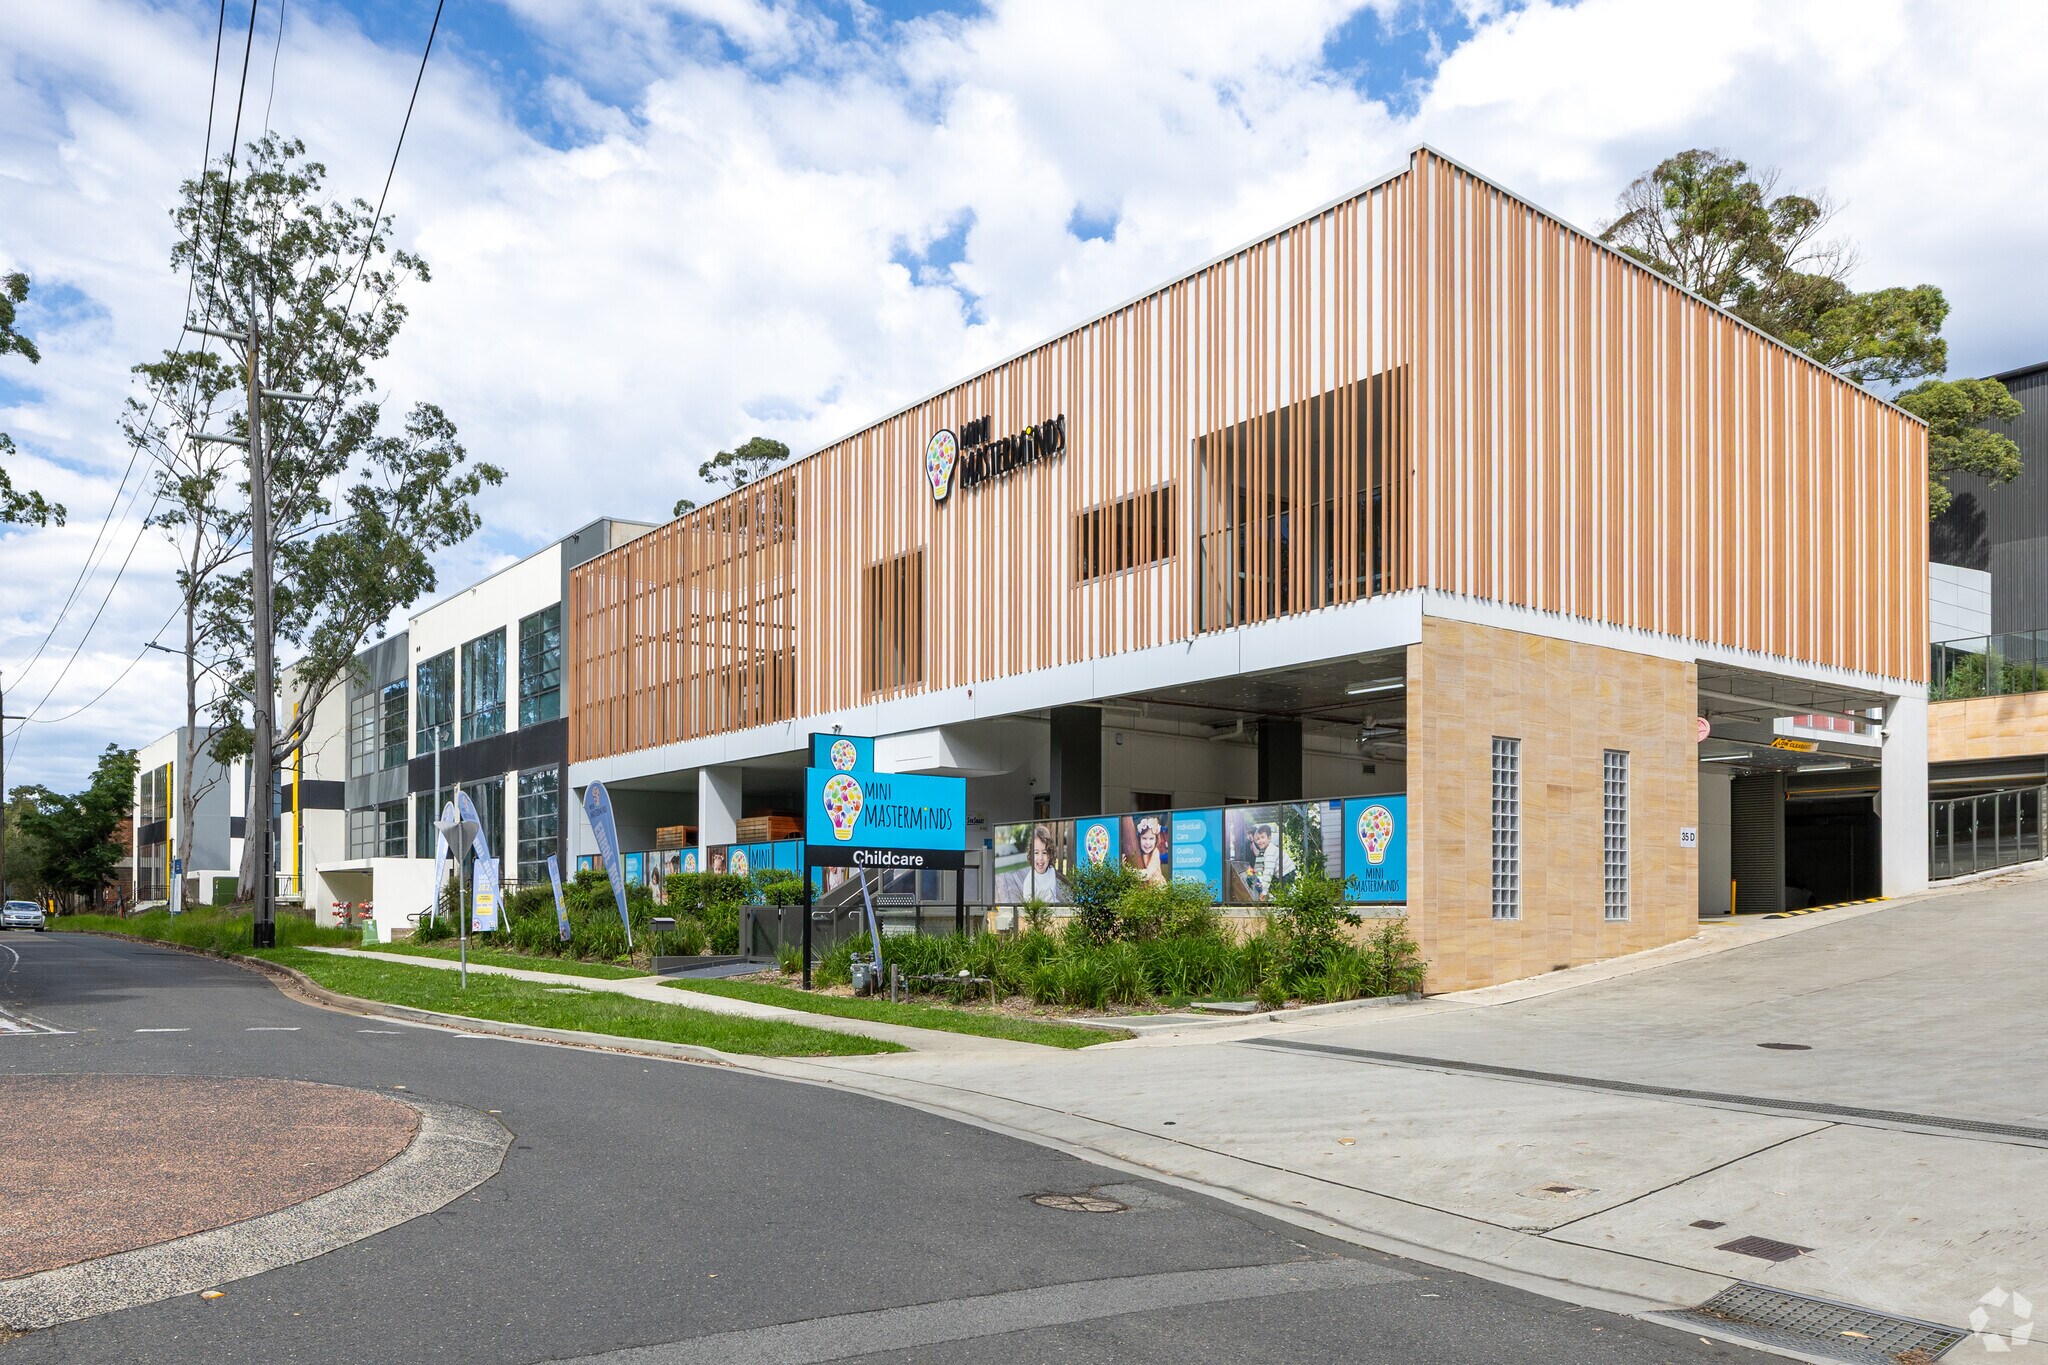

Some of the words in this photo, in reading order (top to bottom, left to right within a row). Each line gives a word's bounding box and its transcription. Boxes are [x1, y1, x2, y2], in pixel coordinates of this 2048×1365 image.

[960, 415, 991, 450] MINI
[864, 782, 891, 800] MINI
[1176, 822, 1201, 831] Individual
[1176, 832, 1189, 841] Care
[1681, 832, 1689, 841] 35
[1690, 832, 1696, 841] D
[1176, 847, 1194, 856] Quality
[751, 849, 770, 869] MINI
[853, 850, 924, 866] Childcare
[1176, 856, 1201, 864] Education
[1365, 867, 1384, 880] MINI
